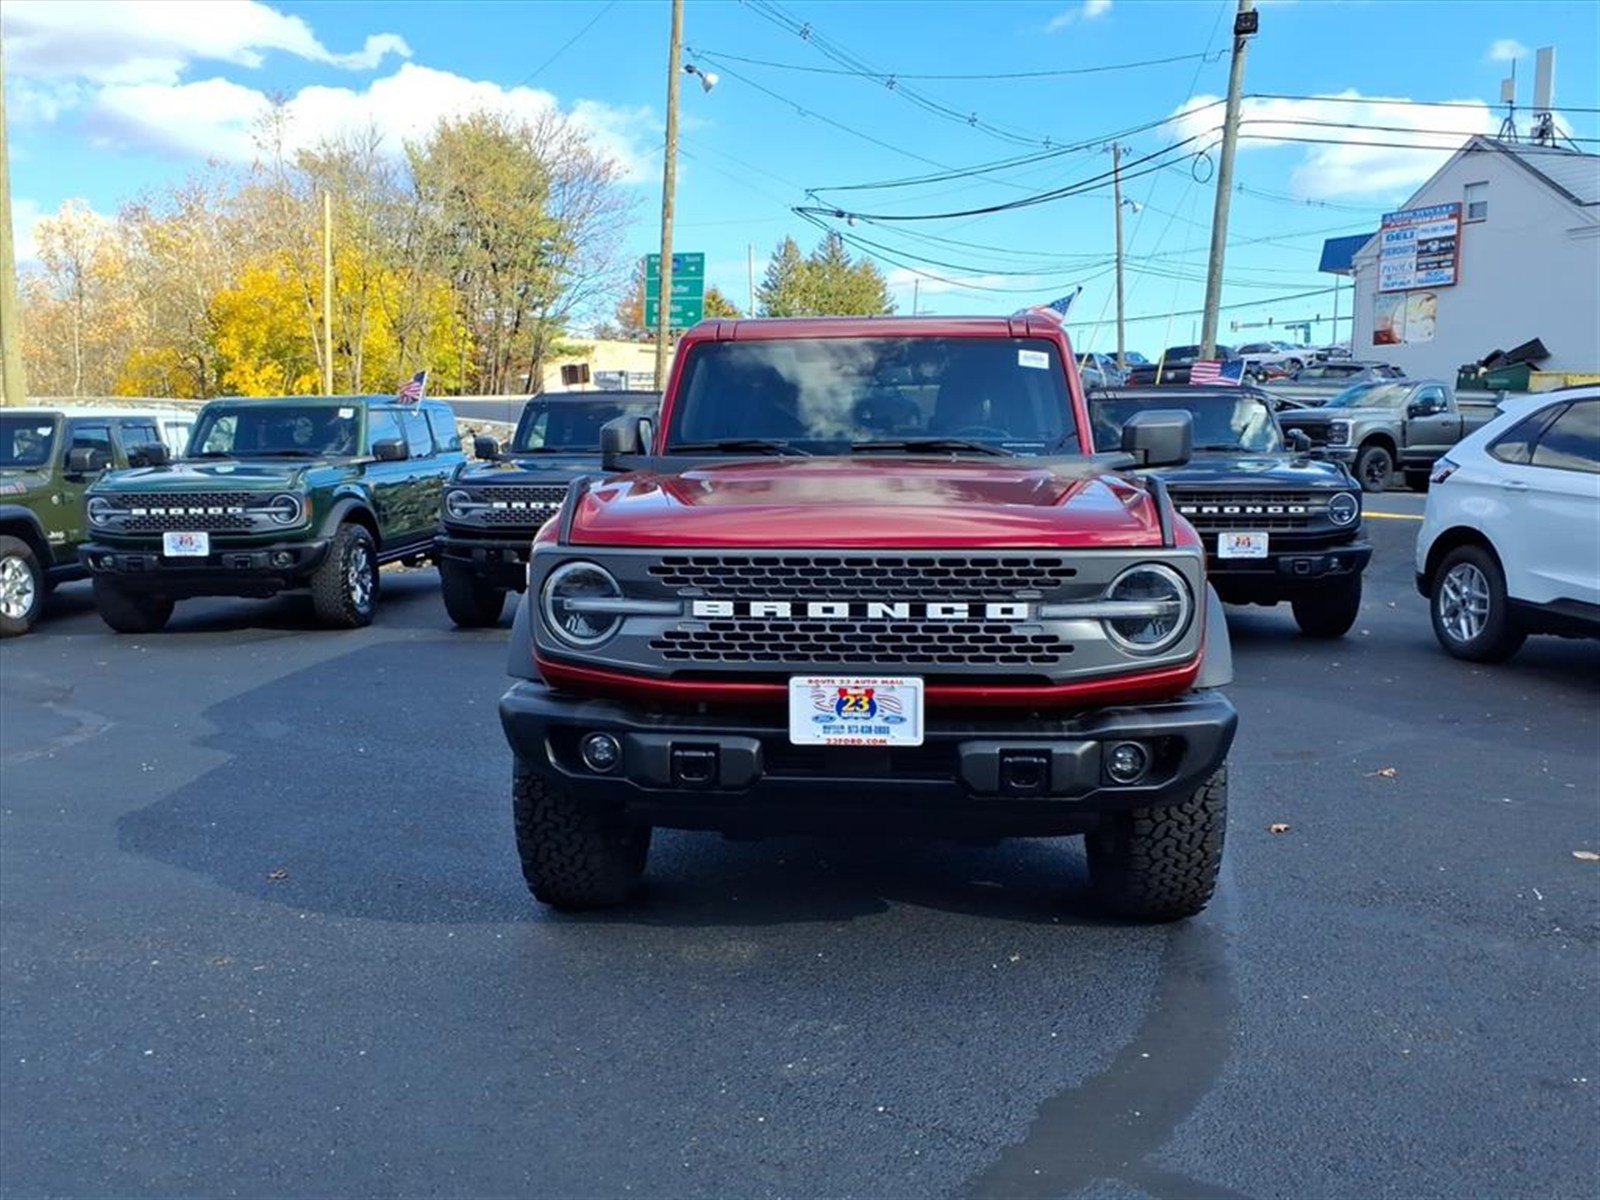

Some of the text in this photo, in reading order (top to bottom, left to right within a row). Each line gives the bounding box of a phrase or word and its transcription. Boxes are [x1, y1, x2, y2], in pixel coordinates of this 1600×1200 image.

[1386, 231, 1414, 242] DELI
[693, 600, 1028, 619] BRONCO
[842, 695, 870, 713] 23
